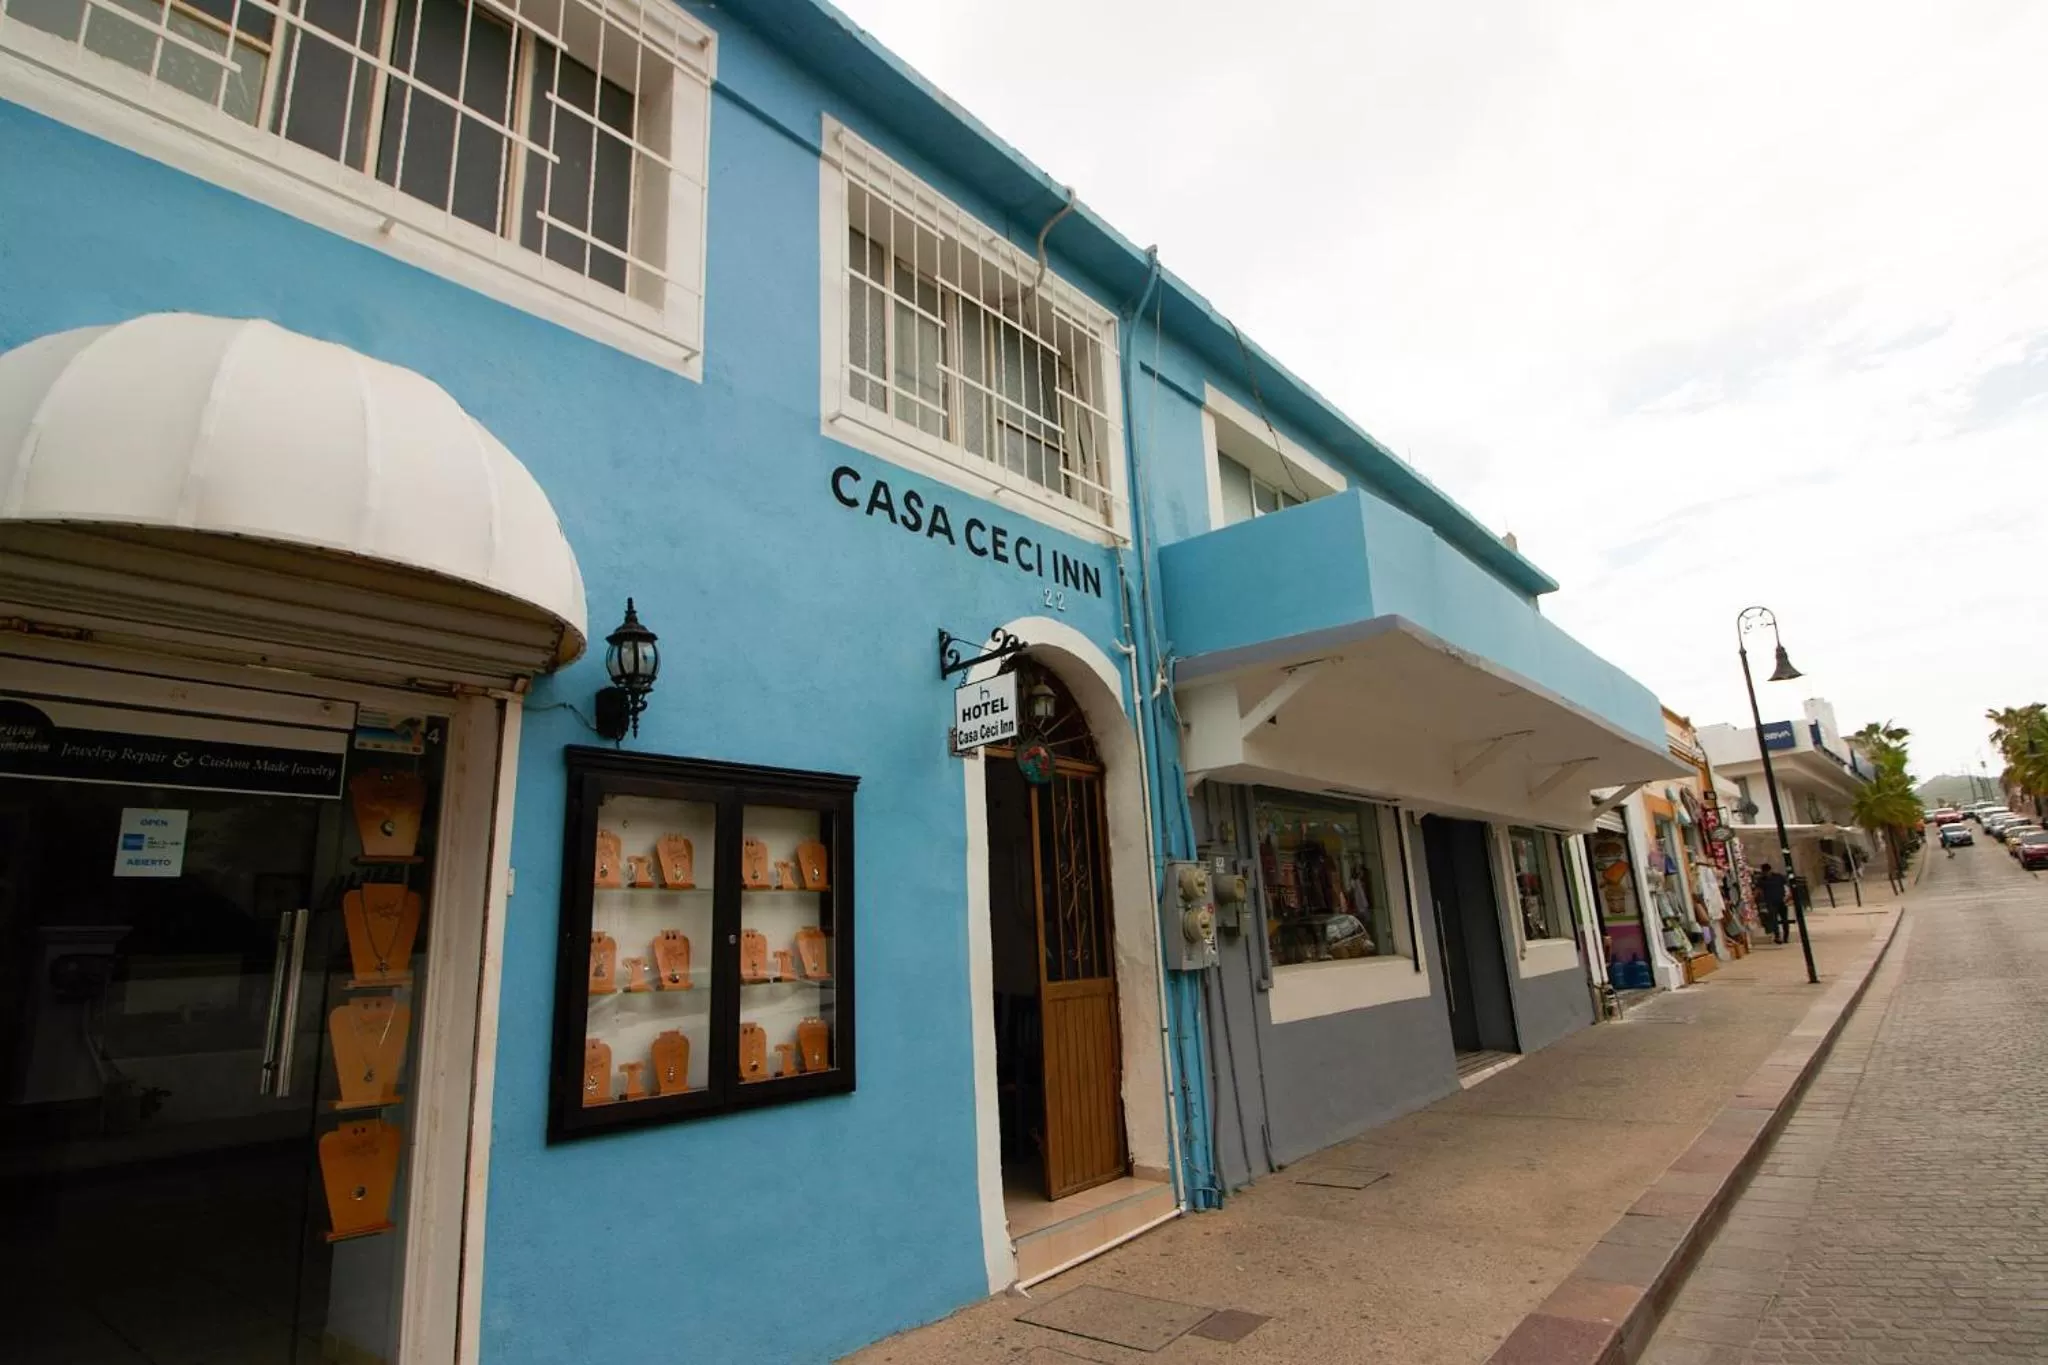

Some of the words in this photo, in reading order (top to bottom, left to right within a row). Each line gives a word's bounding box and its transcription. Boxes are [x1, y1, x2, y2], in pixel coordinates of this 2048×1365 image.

[831, 465, 956, 545] CASA
[964, 518, 1043, 577] CECI
[1052, 550, 1102, 598] INN
[1043, 588, 1066, 612] 22
[962, 697, 1010, 722] HOTEL
[427, 728, 440, 744] 4
[958, 730, 979, 745] Casa
[980, 721, 999, 740] Ceci
[1000, 719, 1014, 734] Inn
[60, 742, 117, 762] Jewelry
[121, 747, 168, 764] Repair
[173, 751, 194, 768] &
[199, 754, 250, 770] Custom
[252, 759, 289, 773] Made
[290, 762, 337, 780] Jewelry
[140, 818, 168, 827] OPEN
[126, 858, 172, 866] ABIERTO
